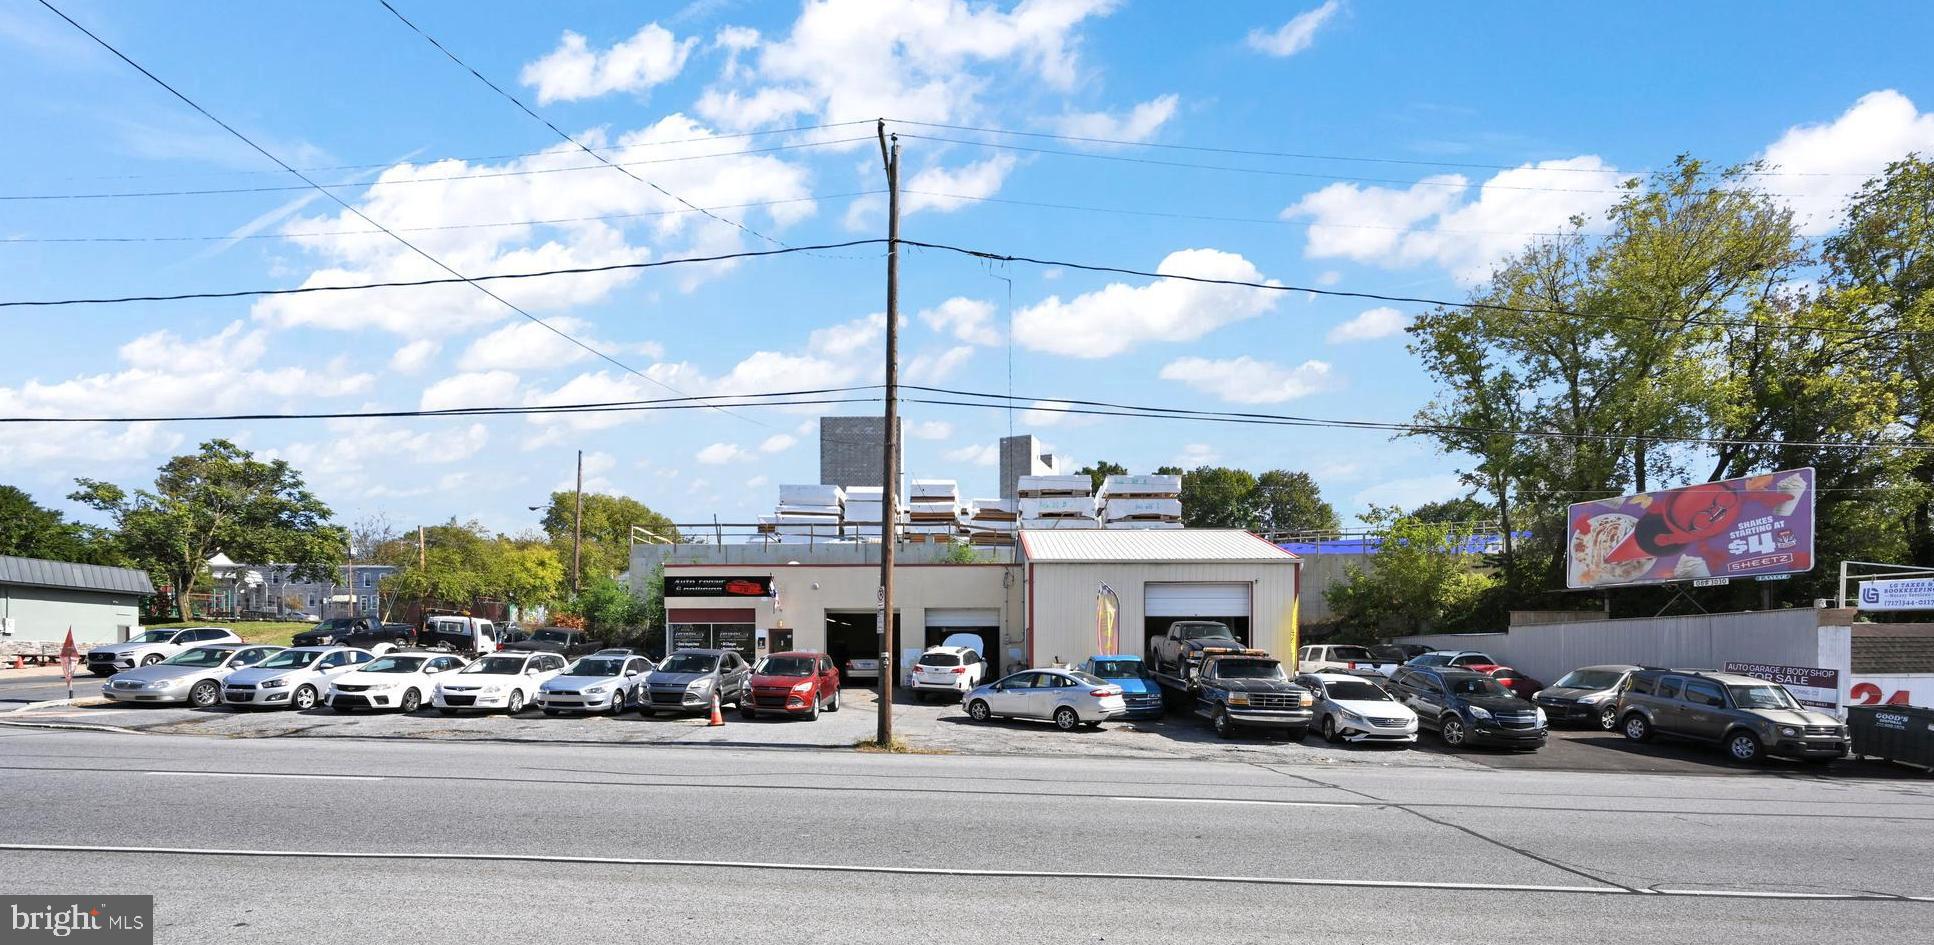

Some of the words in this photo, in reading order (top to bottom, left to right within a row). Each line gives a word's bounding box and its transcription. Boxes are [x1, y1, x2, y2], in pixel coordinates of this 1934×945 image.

[1730, 524, 1772, 539] STARTING
[1774, 520, 1785, 530] AT
[1738, 516, 1773, 530] SHAKES
[1728, 532, 1776, 555] $4
[1732, 555, 1788, 570] SHEETZ
[1728, 663, 1748, 672] AUTO
[1749, 664, 1780, 674] GARAGE
[1787, 668, 1809, 676] BODY
[1810, 669, 1835, 678] SHOP
[1776, 675, 1809, 685] SALE
[1875, 712, 1909, 722] GOOD'S
